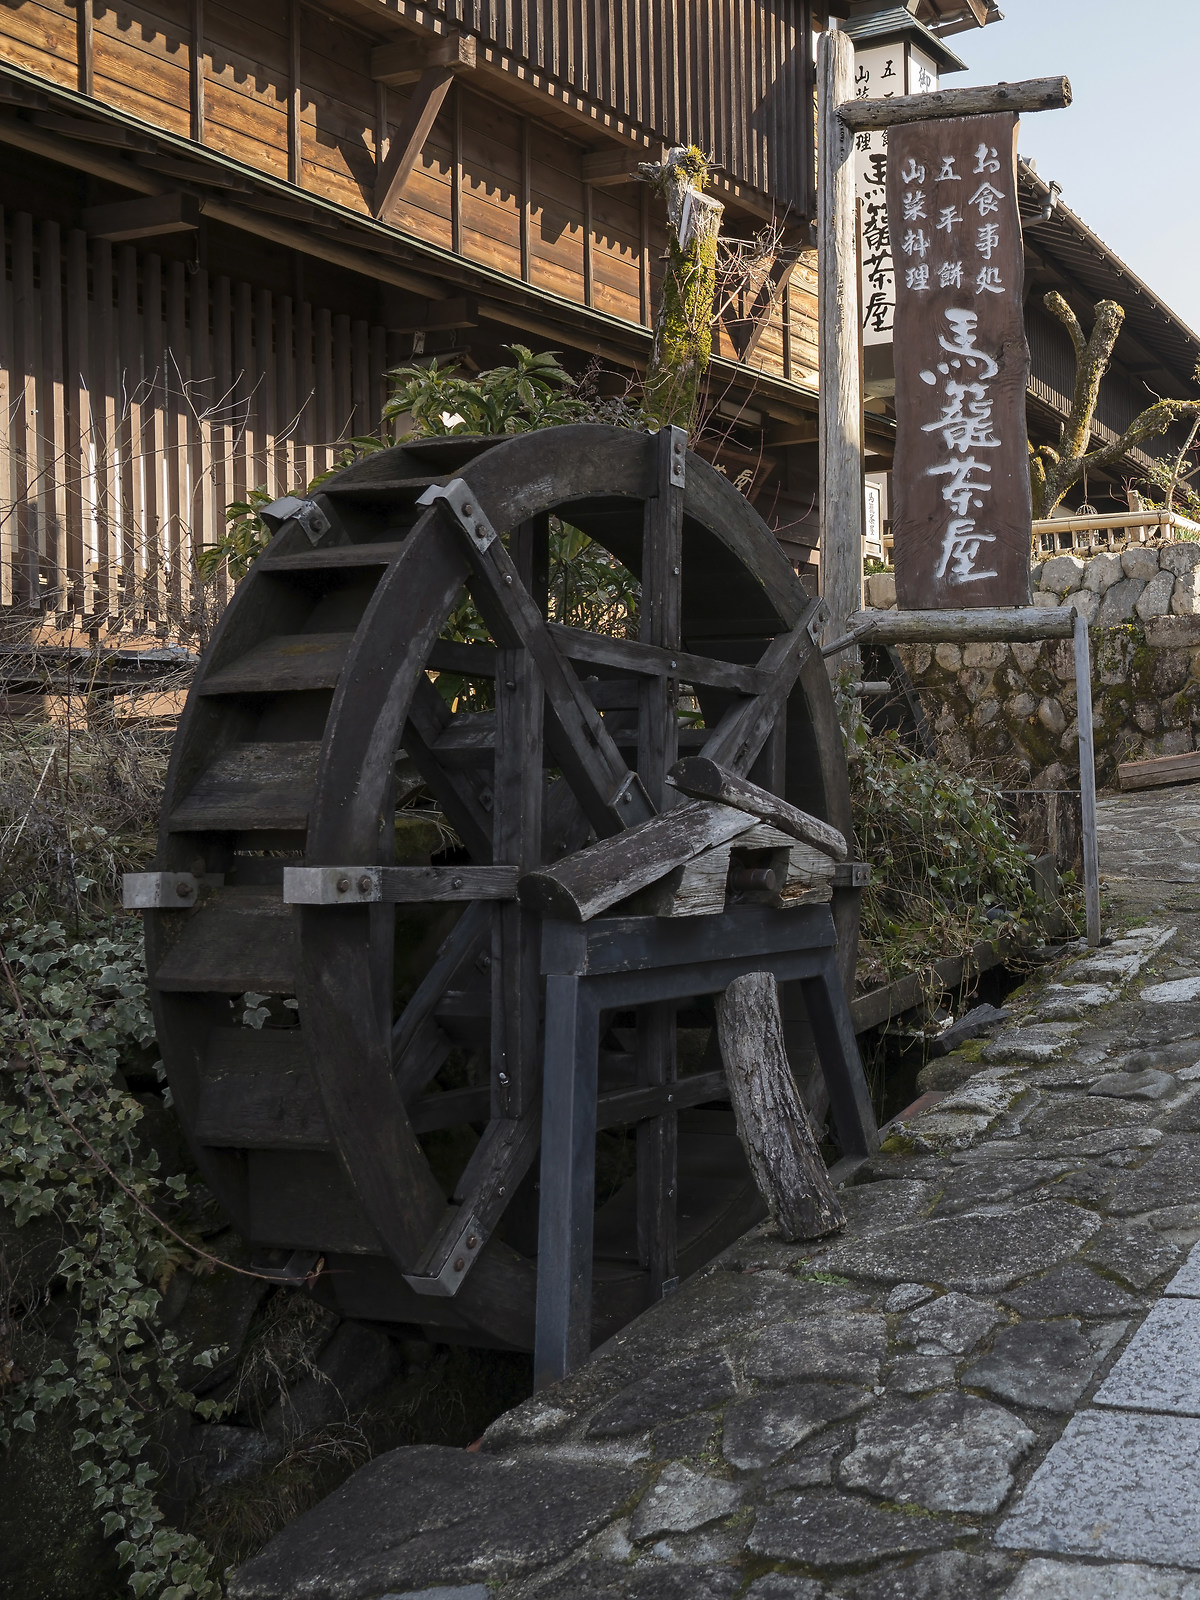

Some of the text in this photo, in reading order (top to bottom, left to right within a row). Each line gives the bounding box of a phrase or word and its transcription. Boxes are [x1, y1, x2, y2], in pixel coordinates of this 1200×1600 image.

[902, 158, 930, 292] 山菜料理
[935, 157, 963, 290] 五平餅
[968, 143, 1006, 294] お食事処
[919, 308, 1001, 580] 馬籠茶屋
